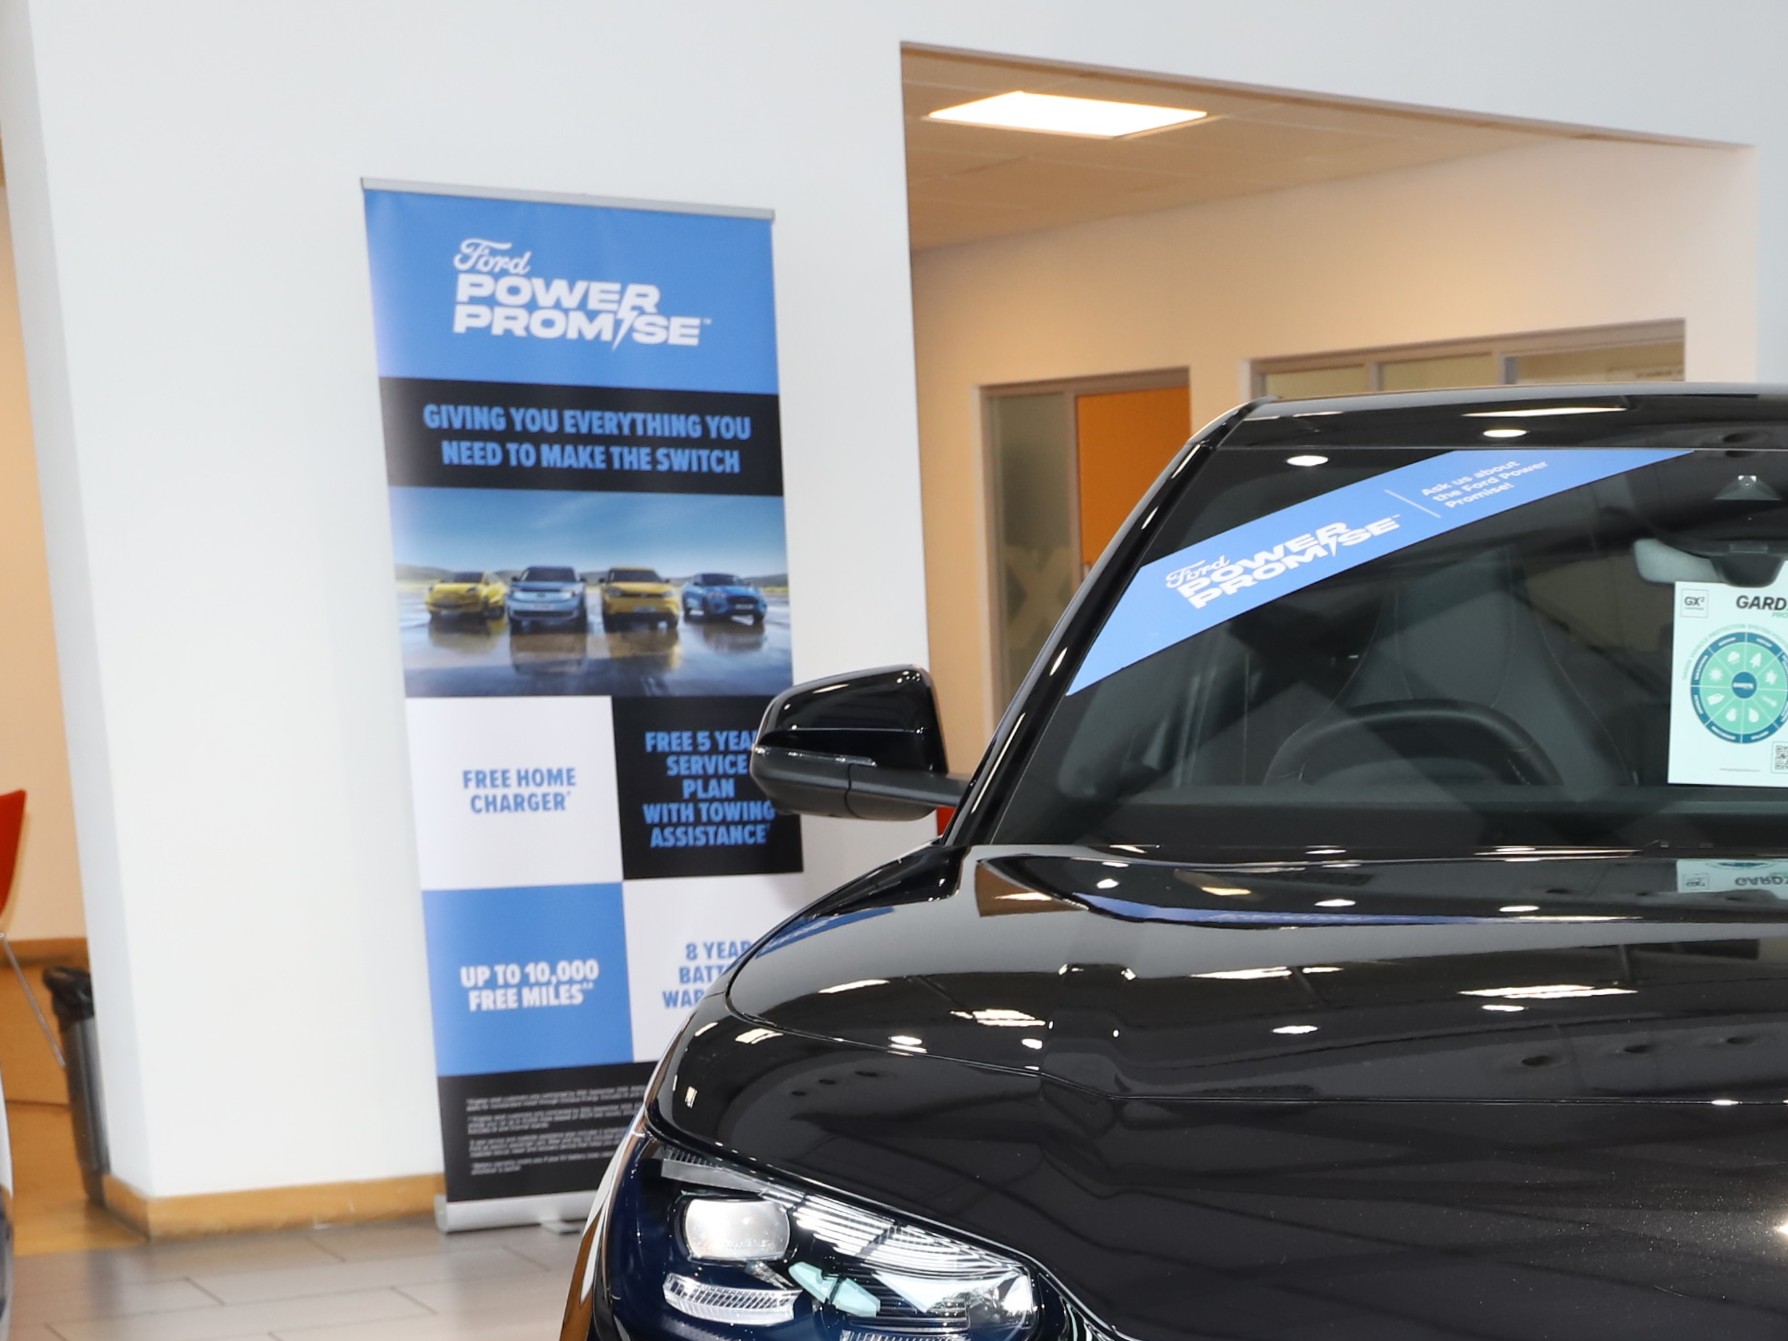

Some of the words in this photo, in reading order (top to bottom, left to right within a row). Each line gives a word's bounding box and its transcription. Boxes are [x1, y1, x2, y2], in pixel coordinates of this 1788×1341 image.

[453, 238, 532, 275] Ford
[456, 273, 661, 318] POWER
[423, 404, 507, 431] GIVING
[509, 406, 559, 434] YOU
[562, 409, 702, 438] EVERYTHING
[704, 415, 751, 441] YOU
[441, 440, 503, 467] NEED
[505, 442, 537, 467] TO
[540, 444, 607, 470] MAKE
[608, 446, 653, 472] THE
[655, 448, 741, 474] SWITCH
[1422, 483, 1452, 496] Ask
[1451, 476, 1473, 486] us
[1473, 461, 1520, 479] about
[1432, 490, 1463, 502] the
[1461, 477, 1500, 492] Ford
[1498, 461, 1548, 480] Power
[1165, 554, 1230, 589] Ford
[1176, 522, 1349, 599] POWER
[645, 731, 693, 753] FREE
[696, 731, 712, 751] 5
[714, 729, 758, 751] YEA
[462, 769, 511, 789] FREE
[516, 767, 576, 788] HOME
[666, 753, 748, 777] SERVICE
[682, 778, 736, 799] PLAN
[642, 802, 695, 824] WITH
[698, 800, 776, 822] TOWING
[686, 943, 698, 960] 8
[460, 965, 491, 988] UP
[494, 963, 521, 986] TO
[524, 958, 600, 985] 10,000
[679, 965, 727, 984] BATT
[469, 988, 519, 1012] FREE
